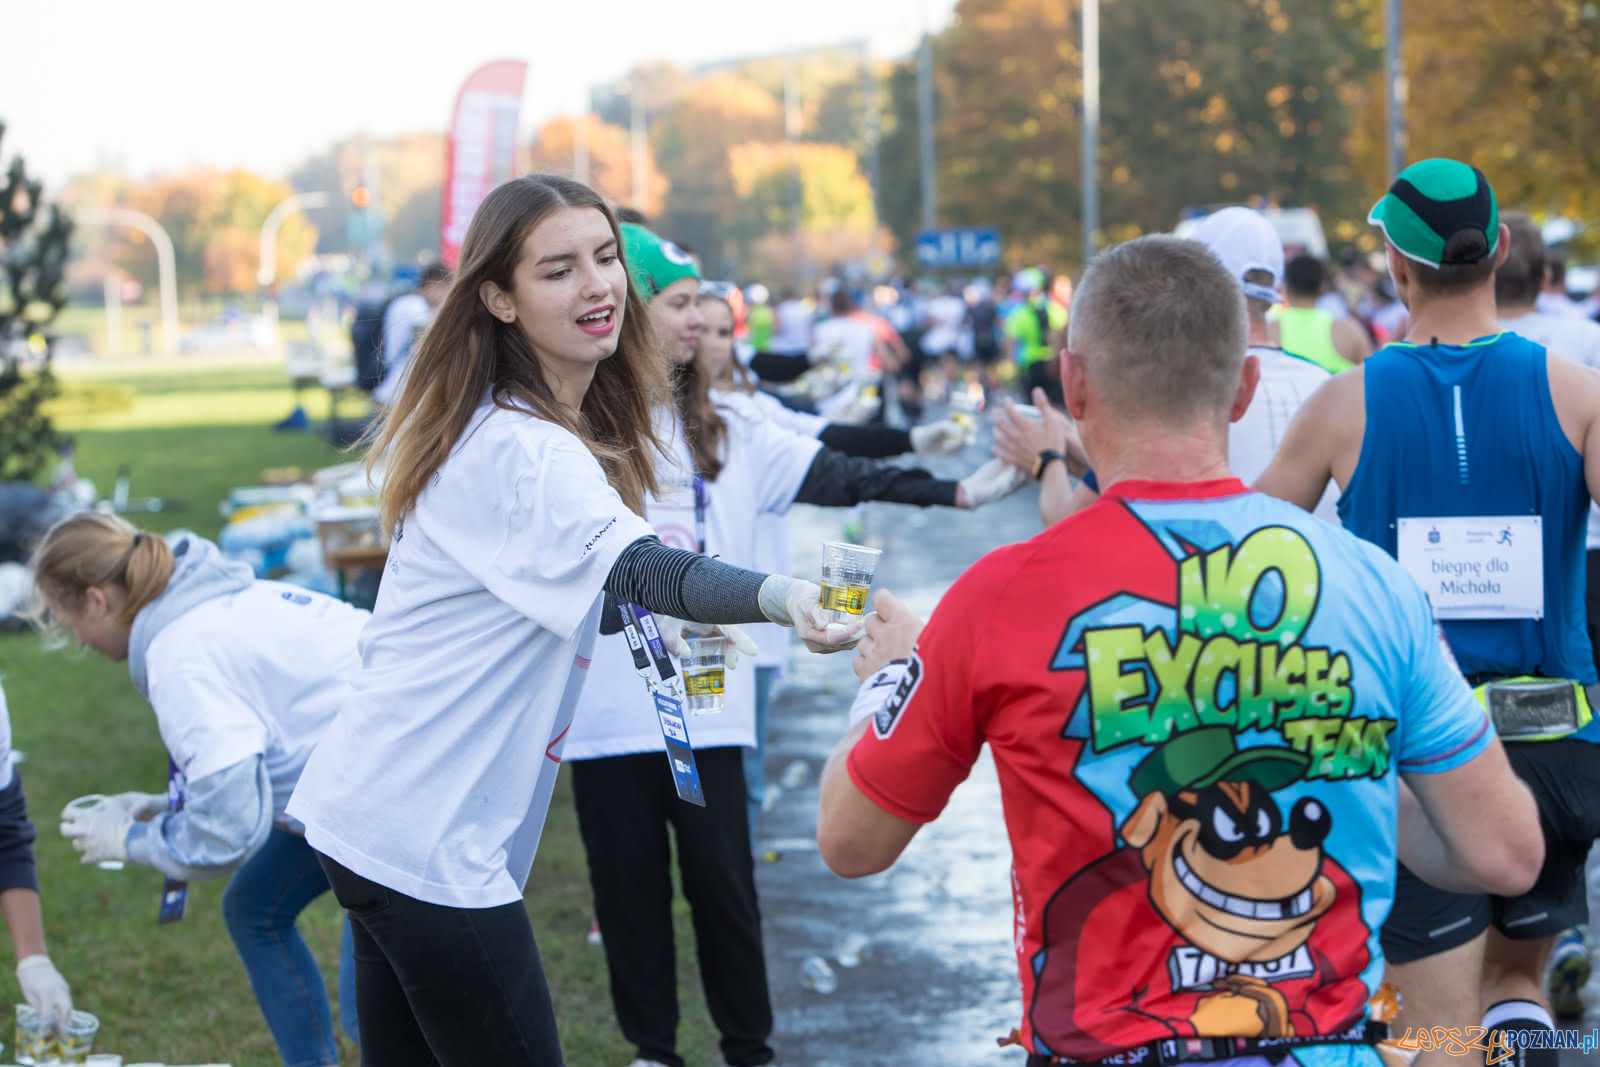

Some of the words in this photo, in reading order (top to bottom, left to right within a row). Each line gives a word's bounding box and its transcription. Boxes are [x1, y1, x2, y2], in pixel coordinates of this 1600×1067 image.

[1177, 524, 1322, 645] NO
[1431, 559, 1481, 577] biegnę
[1486, 557, 1509, 574] dla
[1440, 580, 1501, 595] Michała
[1085, 624, 1354, 754] EXCUSES
[1283, 715, 1398, 782] TEAM
